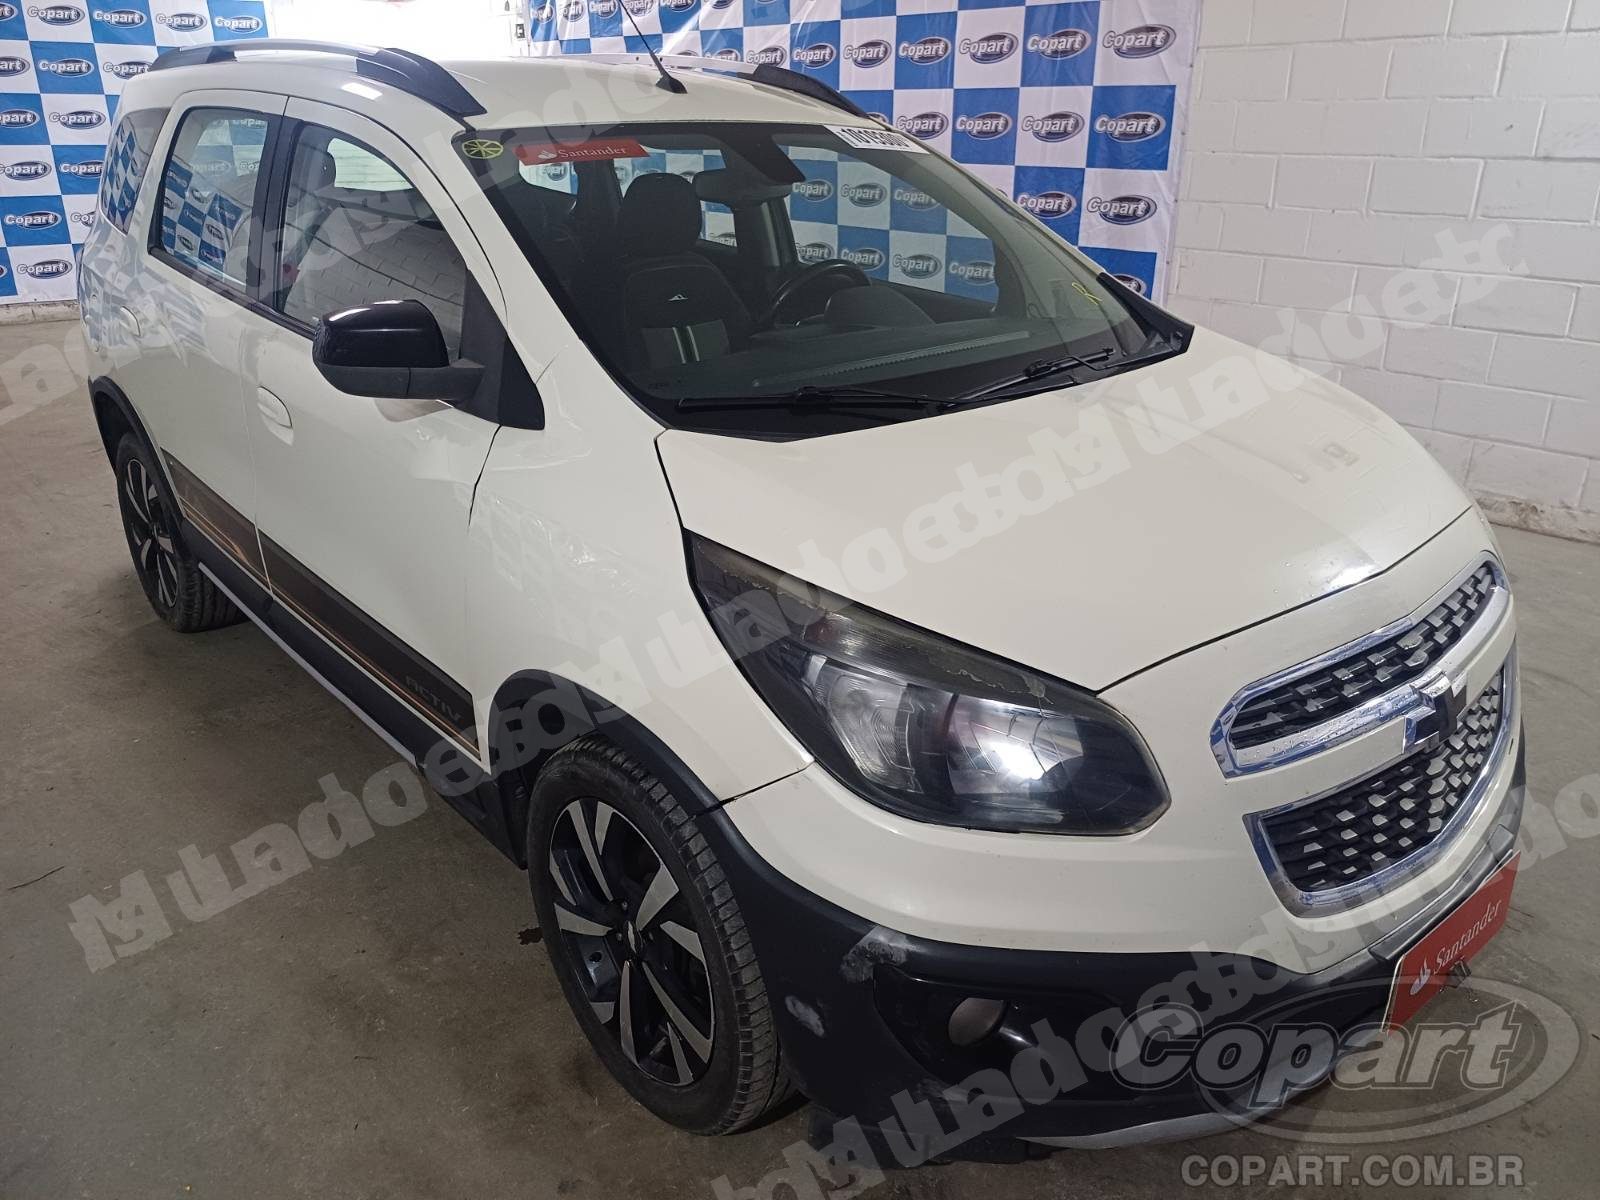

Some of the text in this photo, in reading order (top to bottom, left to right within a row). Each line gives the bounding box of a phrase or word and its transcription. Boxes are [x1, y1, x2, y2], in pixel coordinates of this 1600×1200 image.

[28, 6, 79, 19] Copart
[94, 10, 142, 22] Copart
[156, 13, 201, 27] Copart
[215, 16, 258, 29] Copart
[959, 36, 1010, 54] Copart
[1027, 33, 1082, 55] Copart
[1103, 30, 1168, 53] Copart
[746, 50, 782, 64] Copart
[791, 46, 832, 63] Copart
[843, 44, 886, 61] Copart
[898, 41, 945, 60] Copart
[39, 60, 89, 73] Copart
[49, 112, 98, 125] Copart
[897, 116, 942, 134] Copart
[956, 115, 1005, 134] Copart
[1021, 115, 1075, 135] Copart
[1094, 114, 1157, 137] Copart
[559, 145, 627, 158] Santander
[61, 163, 103, 175] Copar
[792, 182, 829, 198] Copart
[840, 184, 881, 200] Copart
[1017, 193, 1068, 213] Copart
[1087, 196, 1148, 218] Copart
[4, 214, 54, 226] Copart
[840, 248, 880, 266] Copart
[893, 254, 935, 273] Copart
[17, 263, 64, 275] Copart
[1433, 900, 1502, 975] Santander
